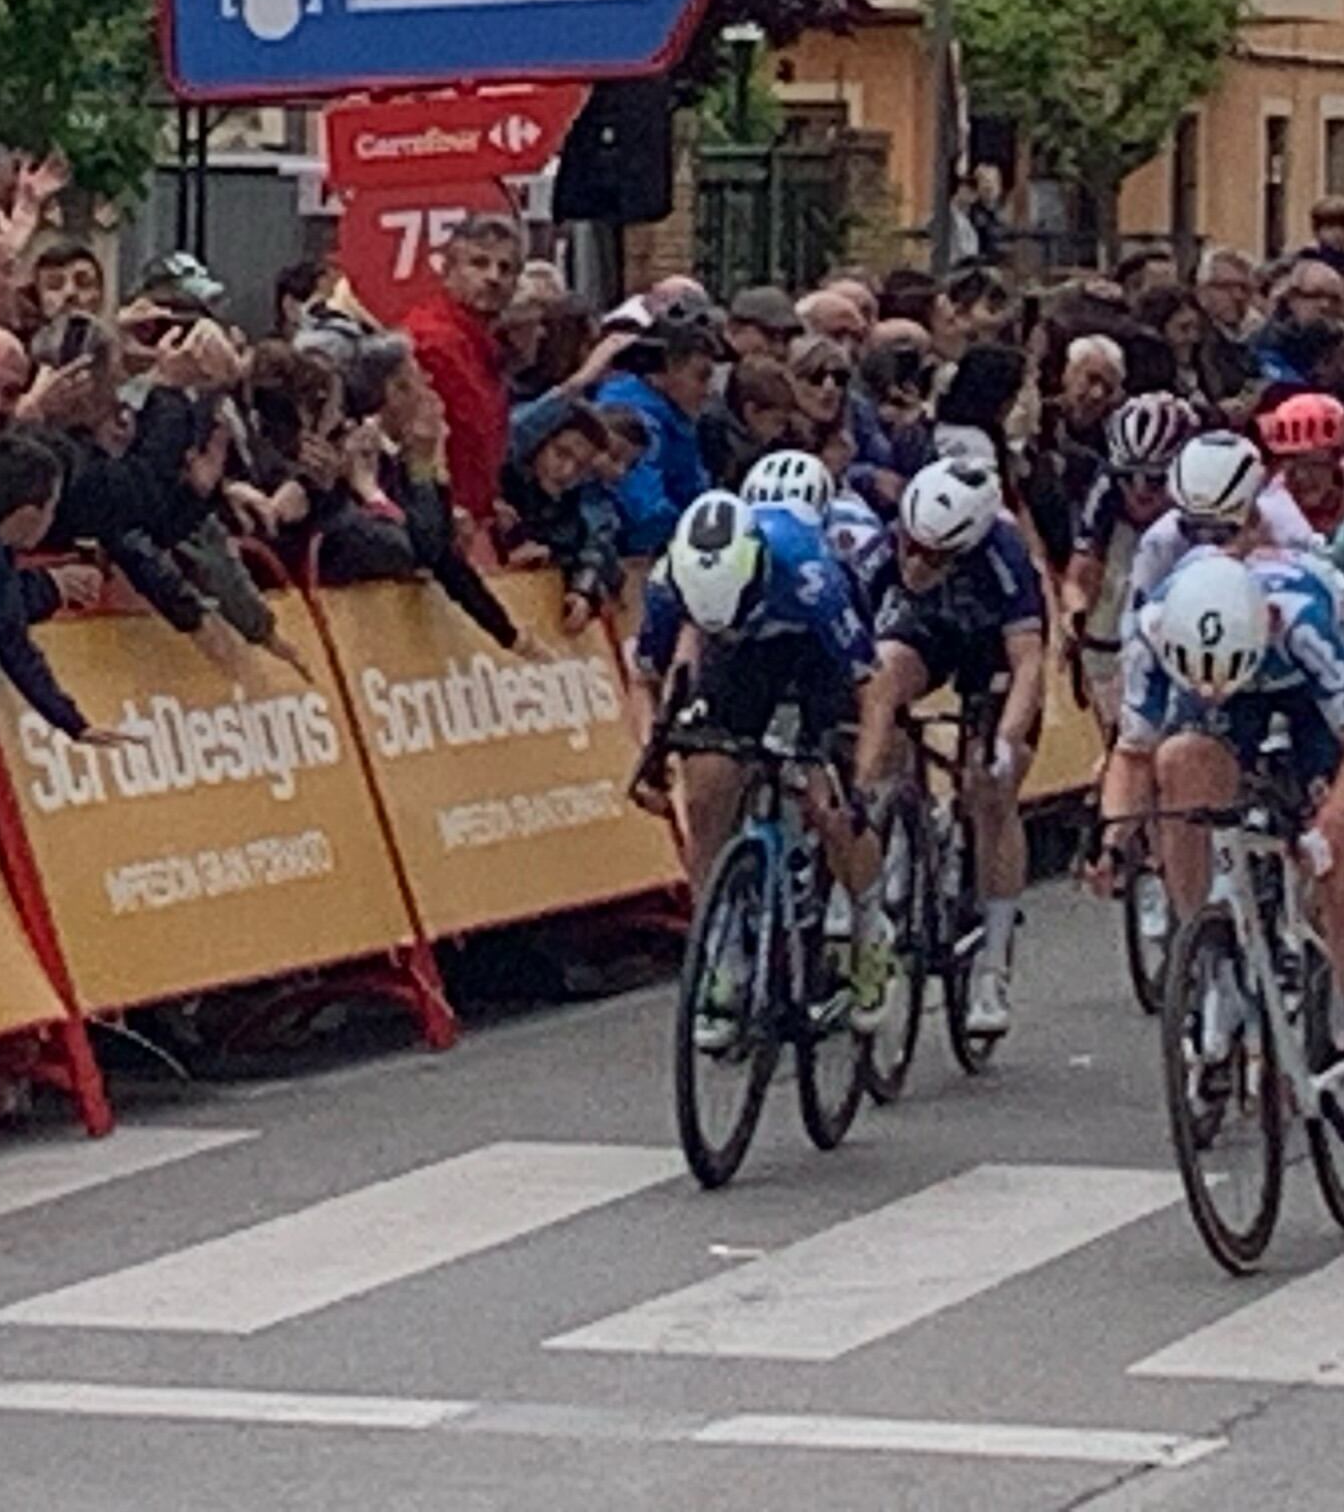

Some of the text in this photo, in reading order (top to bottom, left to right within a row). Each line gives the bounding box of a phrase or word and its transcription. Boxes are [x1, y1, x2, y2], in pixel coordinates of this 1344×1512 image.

[354, 127, 483, 160] Carrefour
[17, 684, 341, 813] ScrubDesigns
[360, 652, 622, 760] ScrubDesigns
